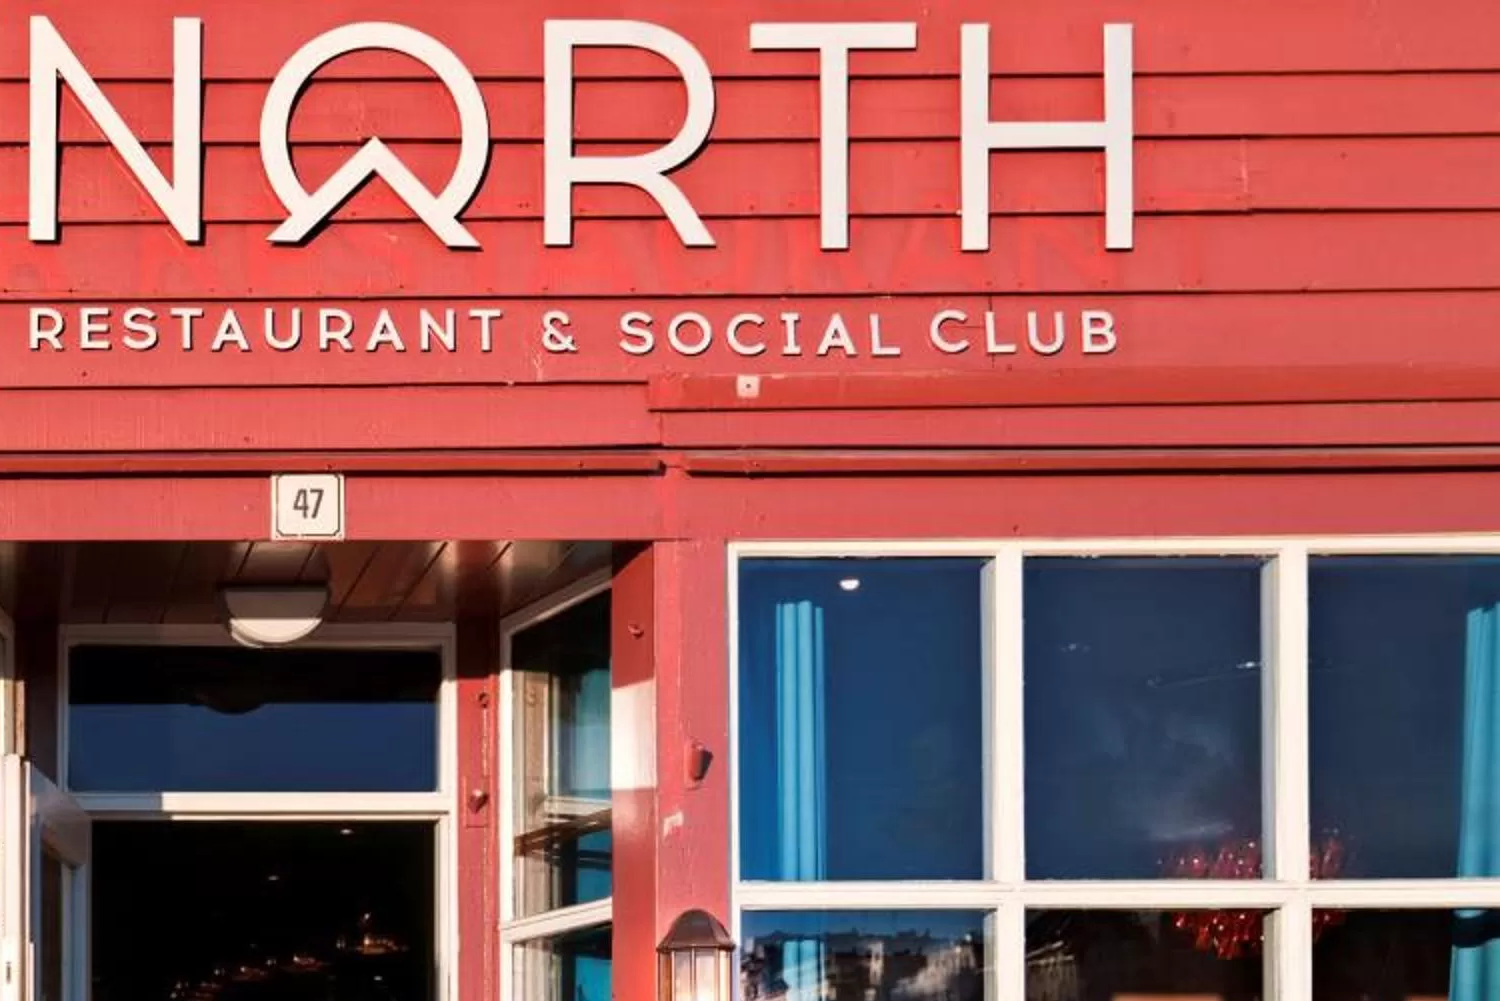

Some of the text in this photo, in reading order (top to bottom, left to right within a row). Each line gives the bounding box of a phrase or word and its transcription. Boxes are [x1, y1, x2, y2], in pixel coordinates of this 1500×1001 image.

[28, 15, 1133, 250] NORTH
[28, 308, 1117, 355] RESTAURANT & SOCIAL CLUB
[293, 488, 324, 519] 47
